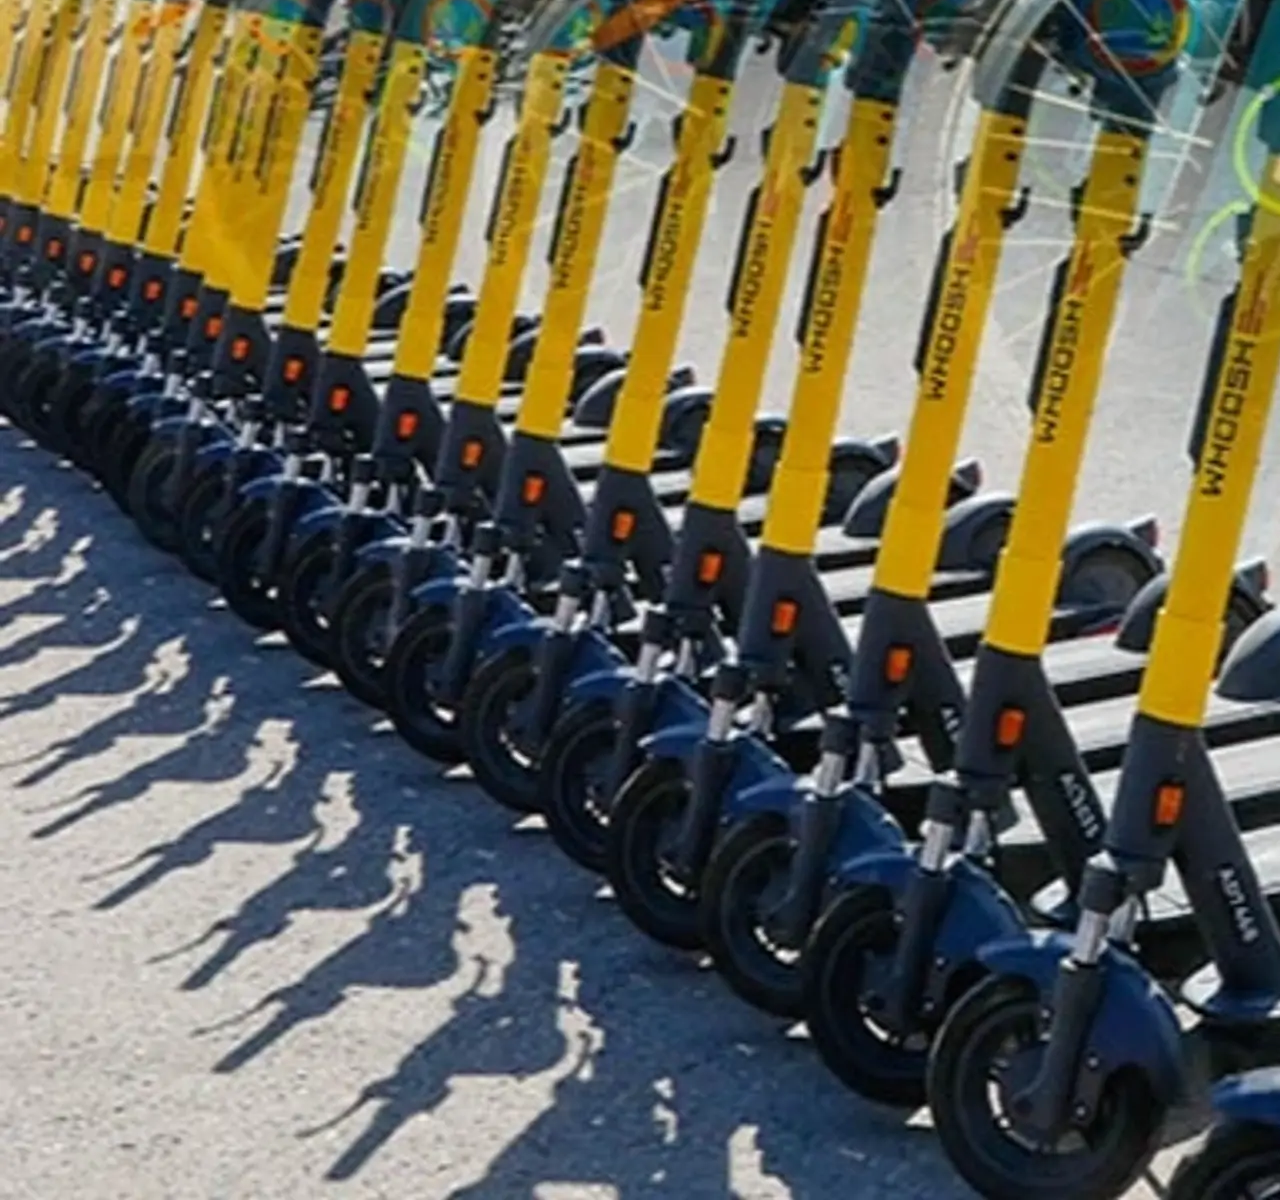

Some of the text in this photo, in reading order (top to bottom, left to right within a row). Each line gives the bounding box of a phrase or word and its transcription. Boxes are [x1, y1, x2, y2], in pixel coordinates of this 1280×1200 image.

[804, 244, 848, 375] WHOOSH
[923, 267, 970, 401] WHOOSH
[1035, 299, 1086, 444] WHOOSH
[1201, 340, 1257, 496] WHOOSH
